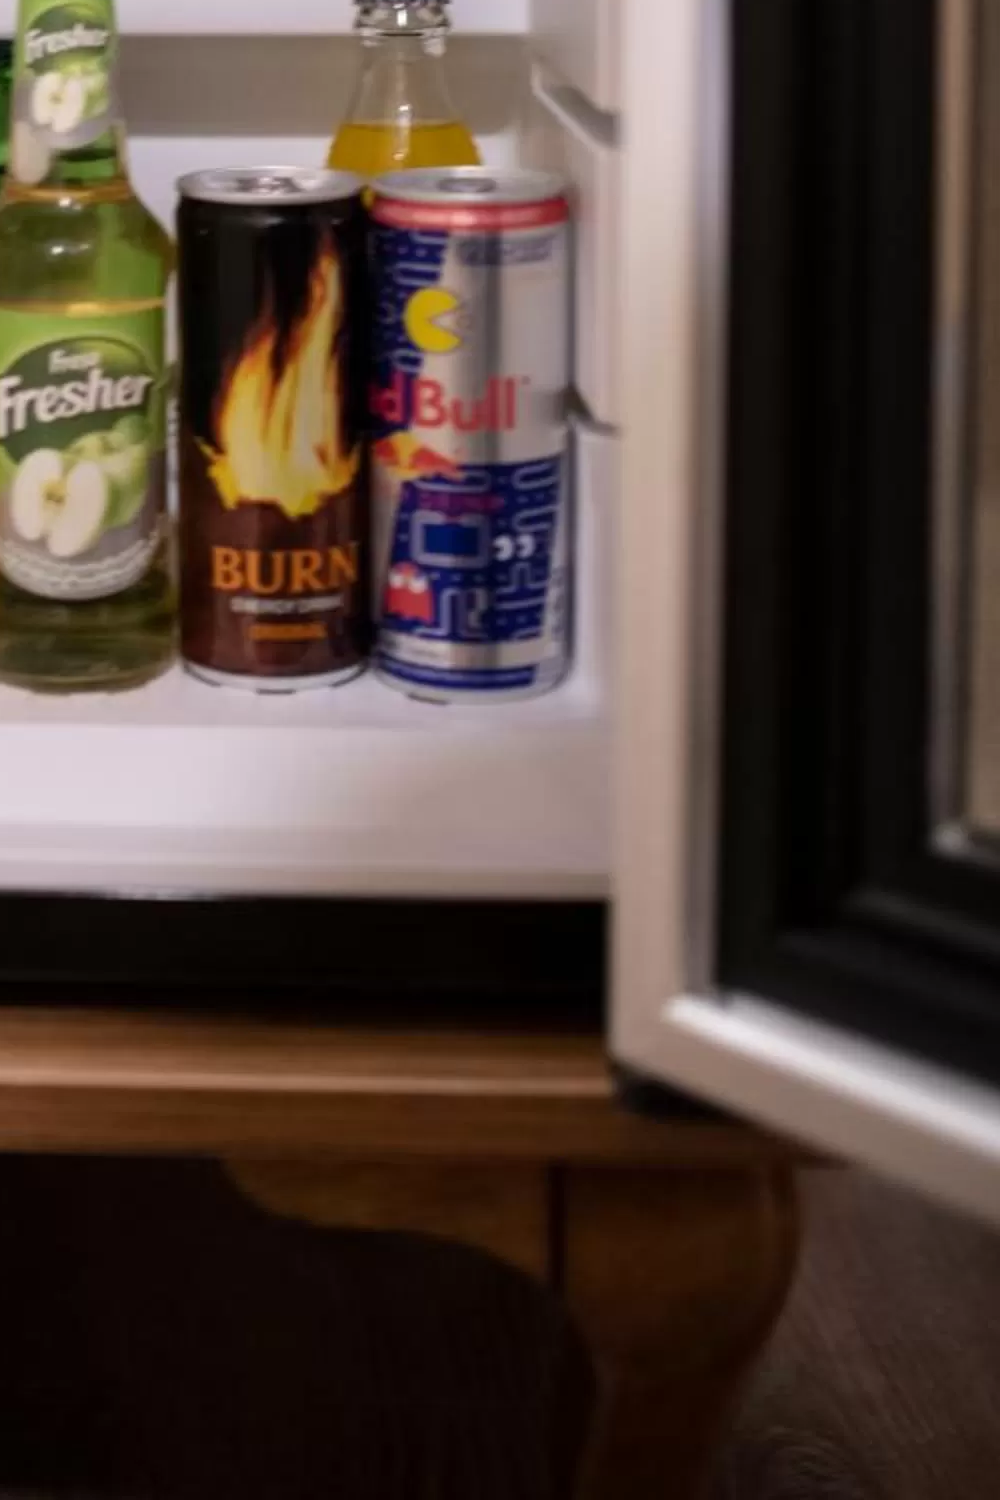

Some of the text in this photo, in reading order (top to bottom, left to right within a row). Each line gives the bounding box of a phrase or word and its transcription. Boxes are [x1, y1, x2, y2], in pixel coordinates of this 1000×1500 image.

[25, 23, 108, 63] Fresher
[413, 375, 516, 433] Bull
[212, 543, 358, 594] BURN
